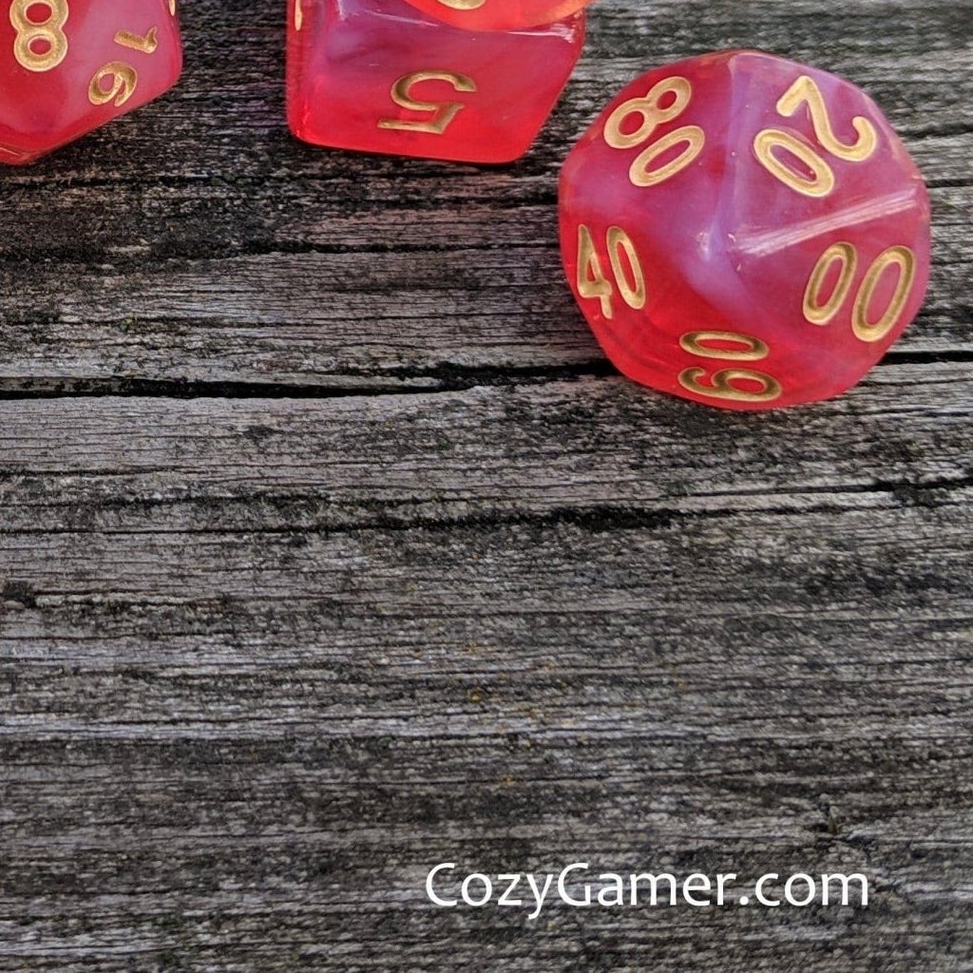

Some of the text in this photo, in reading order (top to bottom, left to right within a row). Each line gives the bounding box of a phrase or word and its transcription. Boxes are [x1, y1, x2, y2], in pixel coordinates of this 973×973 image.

[88, 27, 158, 107] 16
[377, 70, 476, 135] 5
[603, 75, 706, 187] 80
[753, 75, 877, 198] 20
[576, 223, 646, 319] 40
[802, 241, 916, 343] 00
